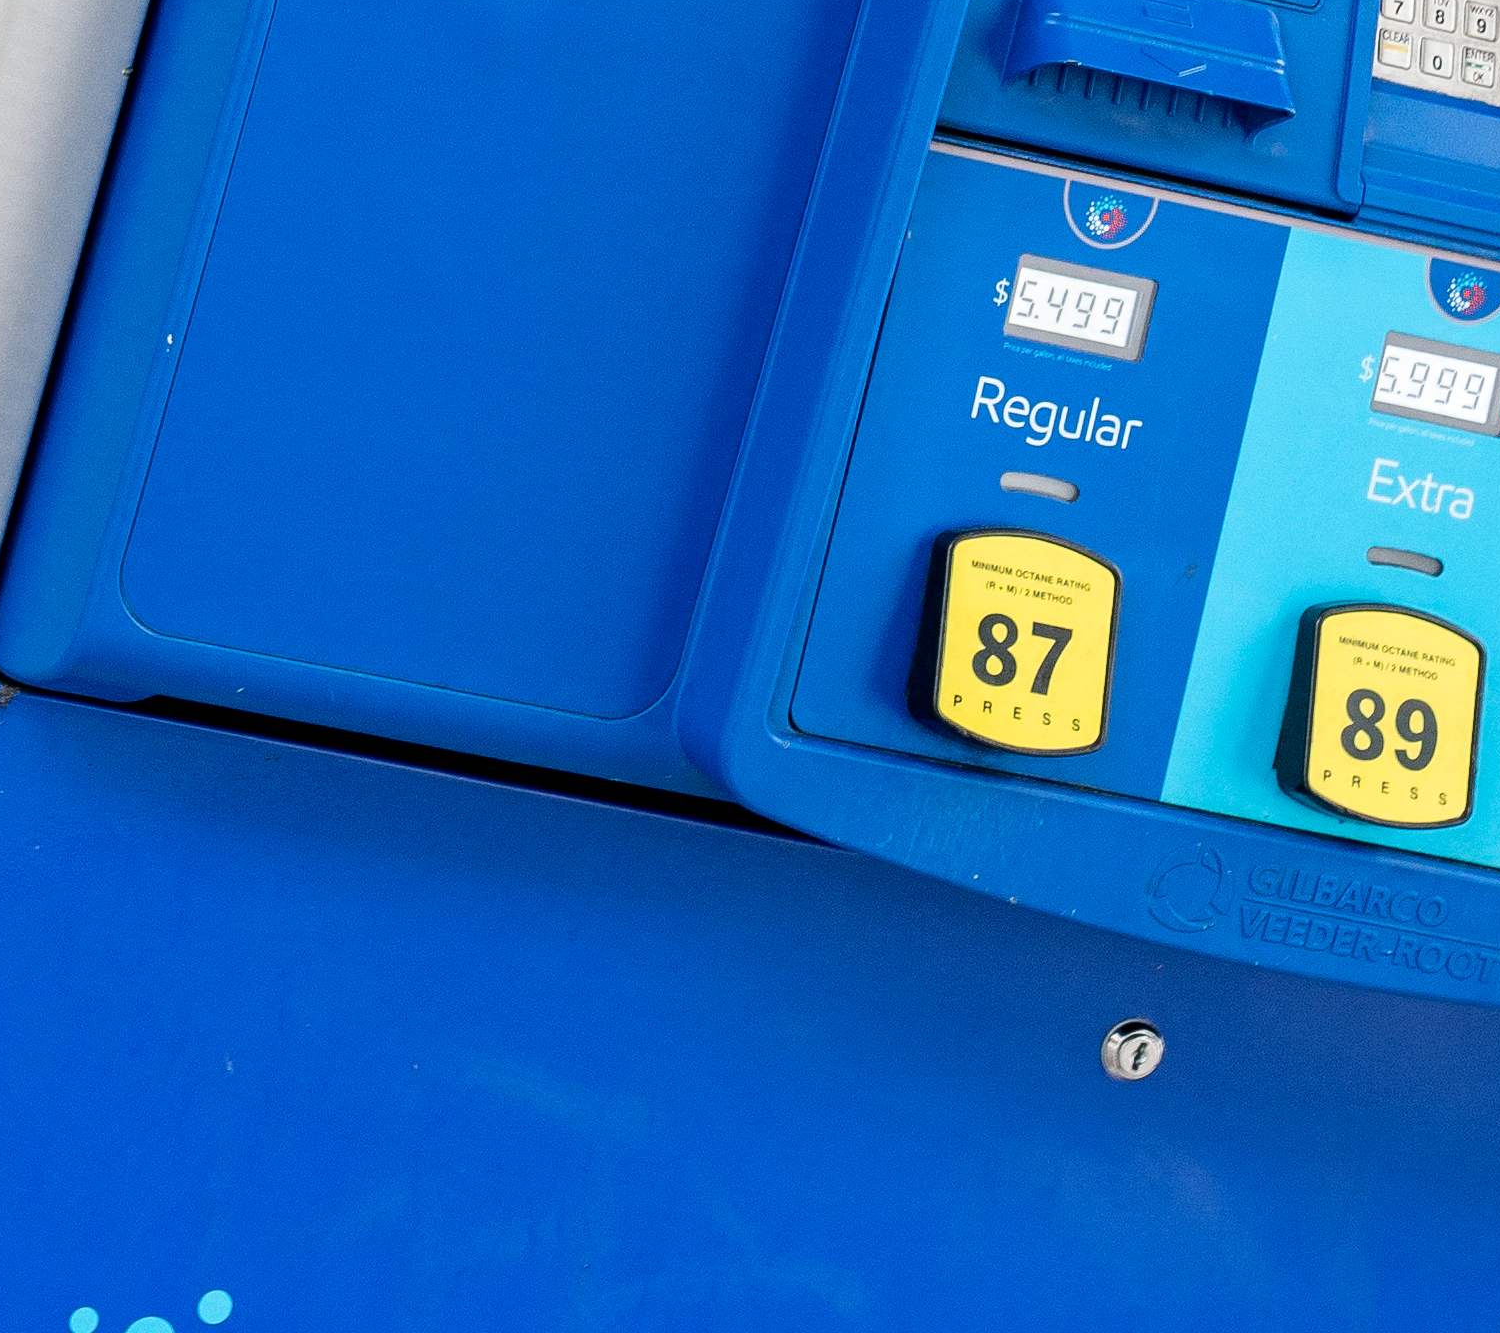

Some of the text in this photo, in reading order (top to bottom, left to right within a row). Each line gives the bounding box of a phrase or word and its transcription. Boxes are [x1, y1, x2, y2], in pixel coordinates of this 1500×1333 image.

[1014, 281, 1128, 334] 5.499
[971, 377, 1143, 452] Regular
[1378, 358, 1486, 411] 5.999
[1366, 457, 1475, 521] Extra
[972, 613, 1075, 697] 87
[1340, 688, 1439, 772] 89
